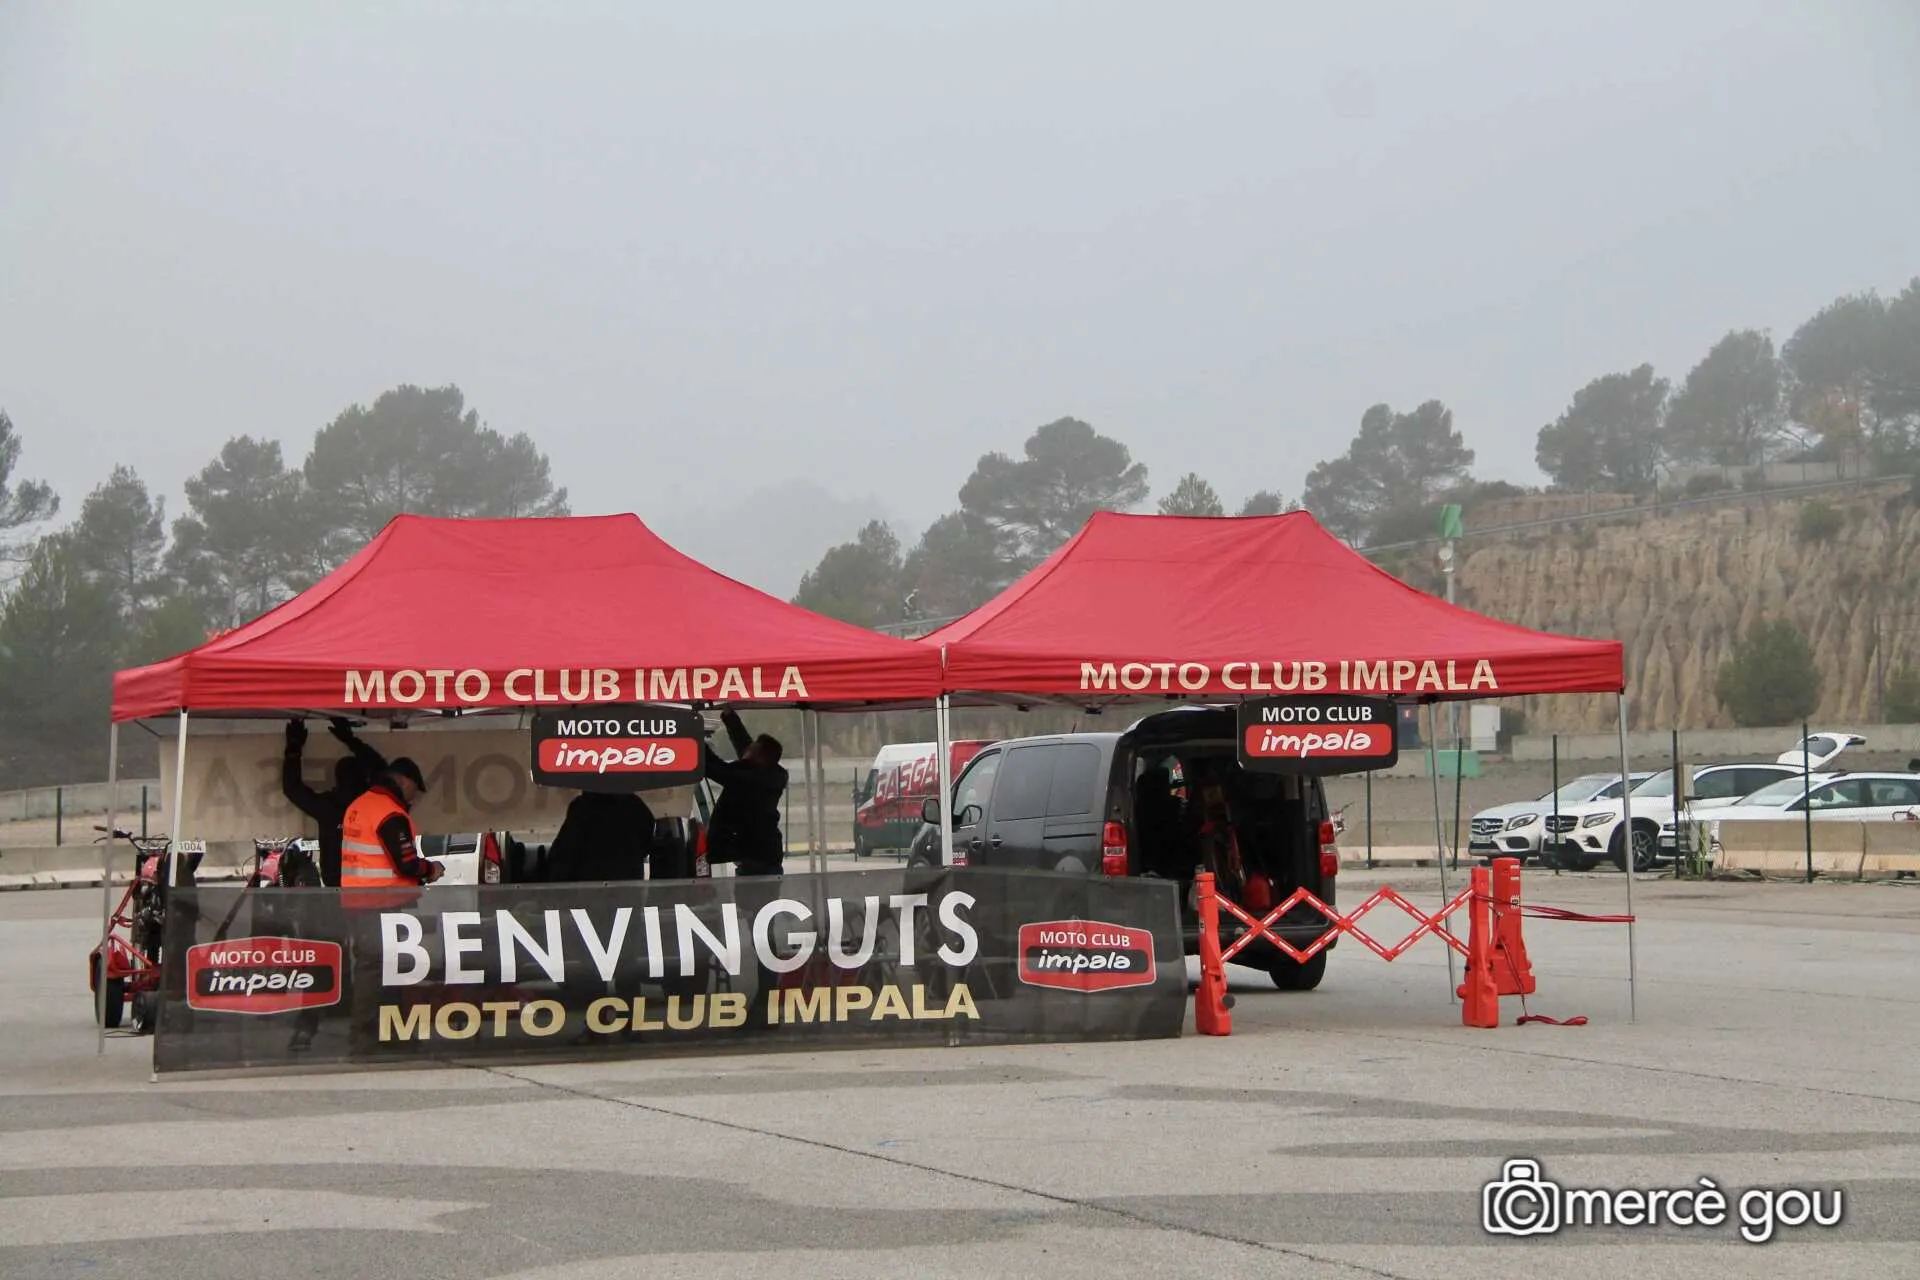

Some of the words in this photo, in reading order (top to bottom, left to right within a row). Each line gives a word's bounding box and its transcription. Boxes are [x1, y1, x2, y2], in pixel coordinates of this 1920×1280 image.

[343, 668, 491, 706] MOTO
[503, 668, 621, 703] CLUB
[635, 666, 810, 701] IMPALA
[1080, 662, 1210, 691] MOTO
[1221, 661, 1328, 691] CLUB
[1340, 659, 1499, 691] IMPALA
[557, 719, 621, 736] MOTO
[627, 719, 677, 735] CLUB
[1262, 706, 1321, 722] MOTO
[1326, 706, 1372, 722] CLUB
[555, 743, 676, 774] impala
[1260, 728, 1372, 759] impala
[379, 890, 980, 987] BENVINGUTS
[1040, 931, 1087, 949] MOTO
[1091, 931, 1131, 948] CLUB
[209, 950, 266, 965] MOTO
[271, 949, 317, 964] CLUB
[1037, 949, 1131, 975] impala
[208, 969, 316, 998] impala
[378, 999, 566, 1041] MOTO
[585, 992, 748, 1034] CLUB
[766, 983, 981, 1025] IMPALA
